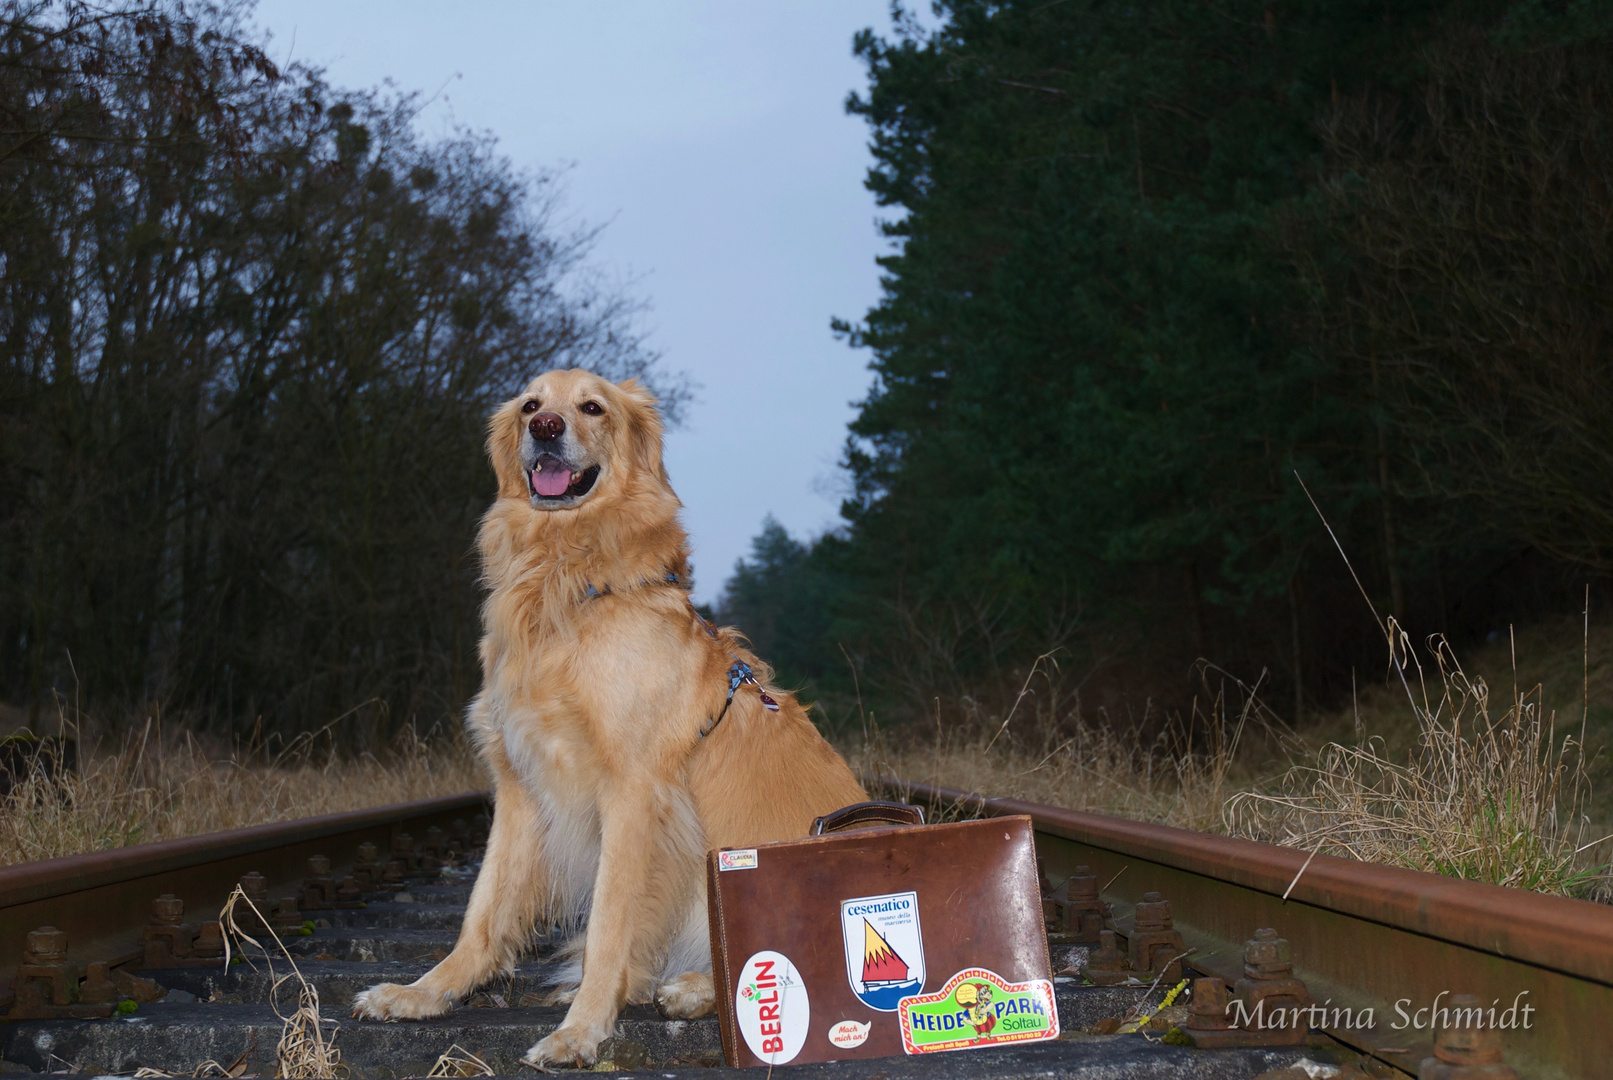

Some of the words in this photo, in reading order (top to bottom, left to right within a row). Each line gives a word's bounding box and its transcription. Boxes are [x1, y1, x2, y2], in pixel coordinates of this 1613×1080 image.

[848, 898, 910, 916] cesenatico
[754, 961, 783, 1053] BERLIN
[912, 1010, 965, 1032] HEIDE
[994, 998, 1045, 1019] PARK
[838, 1025, 858, 1033] Mach
[1002, 1017, 1041, 1031] Soltau
[834, 1033, 851, 1043] mich
[853, 1031, 867, 1040] an!
[923, 1043, 945, 1051] Freizeit
